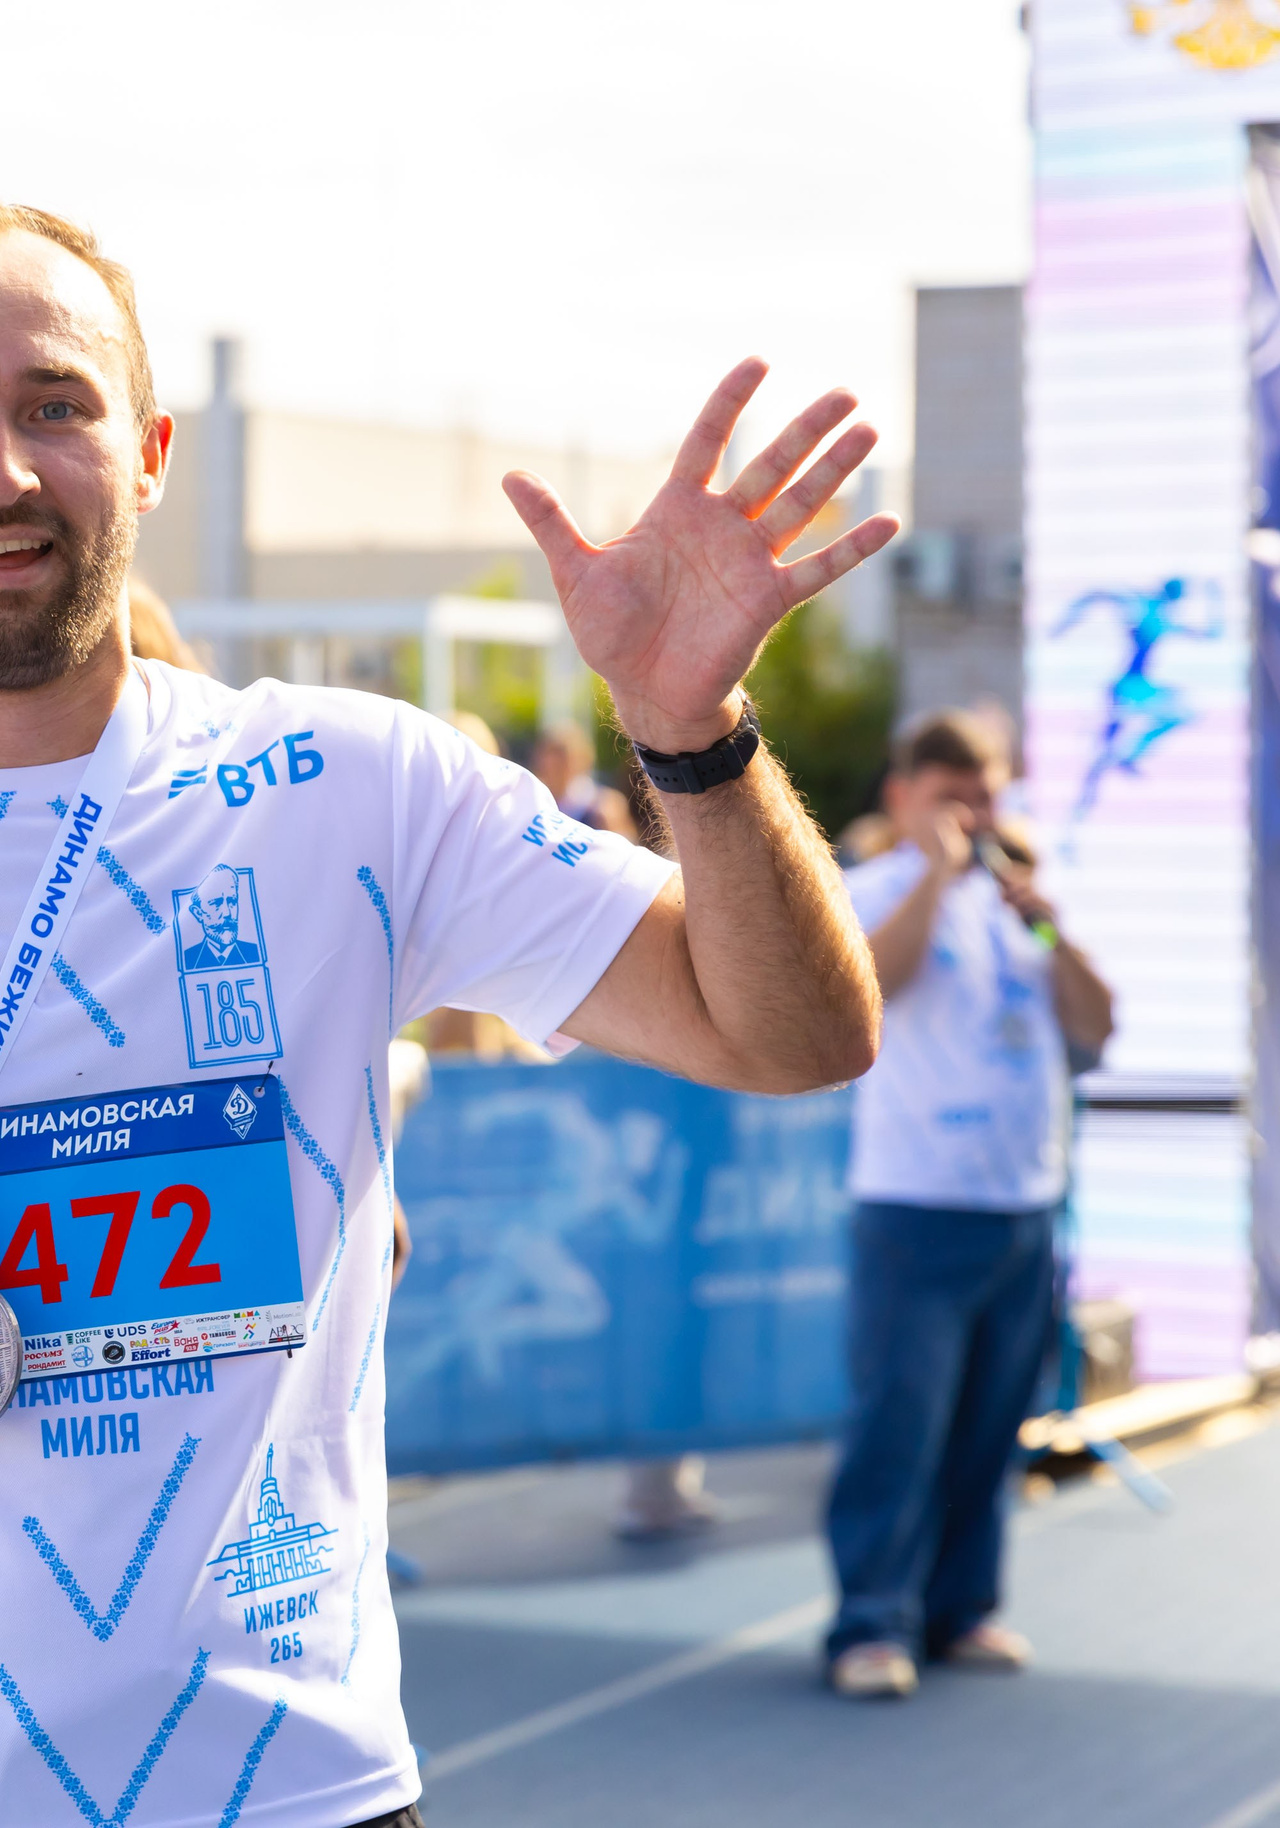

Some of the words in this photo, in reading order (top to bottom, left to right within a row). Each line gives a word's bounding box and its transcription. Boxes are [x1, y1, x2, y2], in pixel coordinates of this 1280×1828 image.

[217, 730, 324, 808] ВТБ
[31, 792, 103, 939] ДИНАМО
[196, 978, 266, 1051] 185
[52, 1129, 131, 1159] МИЛЯ
[24, 1337, 62, 1351] Nika
[75, 1329, 101, 1338] COFFEE
[117, 1325, 147, 1337] UDS
[27, 1360, 66, 1370] РОНДАМИТ
[131, 1347, 171, 1361] Effort
[7, 1360, 214, 1409] НАМОВСКАЯ
[40, 1412, 140, 1459] МИЛЯ
[244, 1589, 318, 1634] ИЖЕВСК
[270, 1631, 303, 1664] 265
